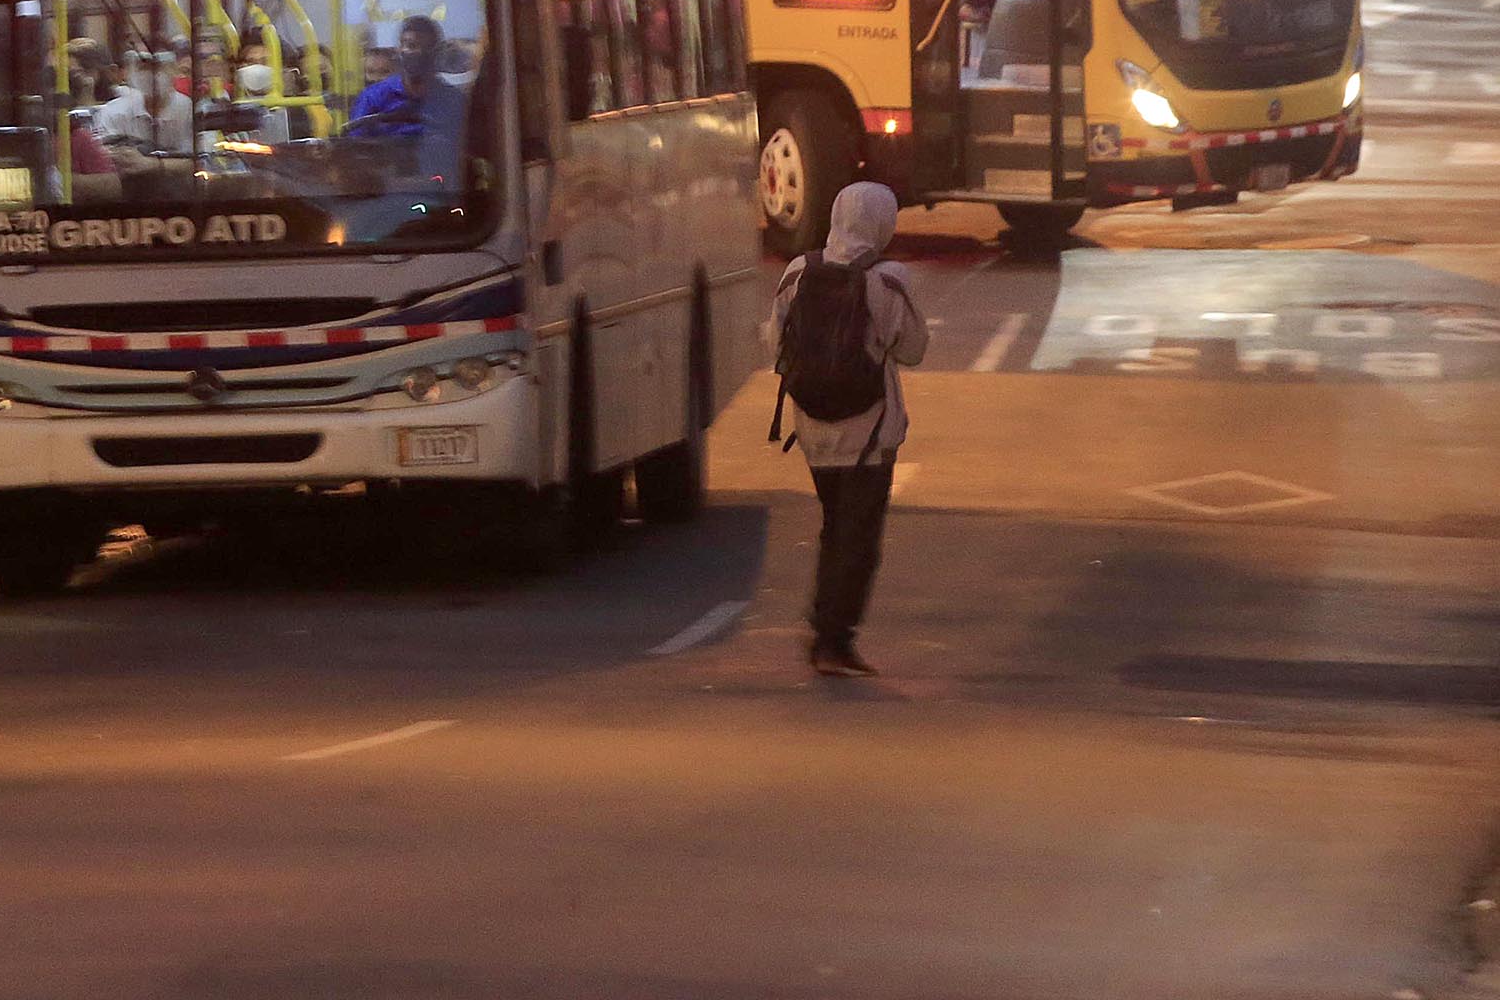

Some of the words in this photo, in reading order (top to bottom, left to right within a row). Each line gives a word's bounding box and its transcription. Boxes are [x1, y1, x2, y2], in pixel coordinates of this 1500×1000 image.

[838, 25, 899, 40] ENTRADA
[50, 216, 196, 248] GRUPO
[201, 214, 288, 244] ATD
